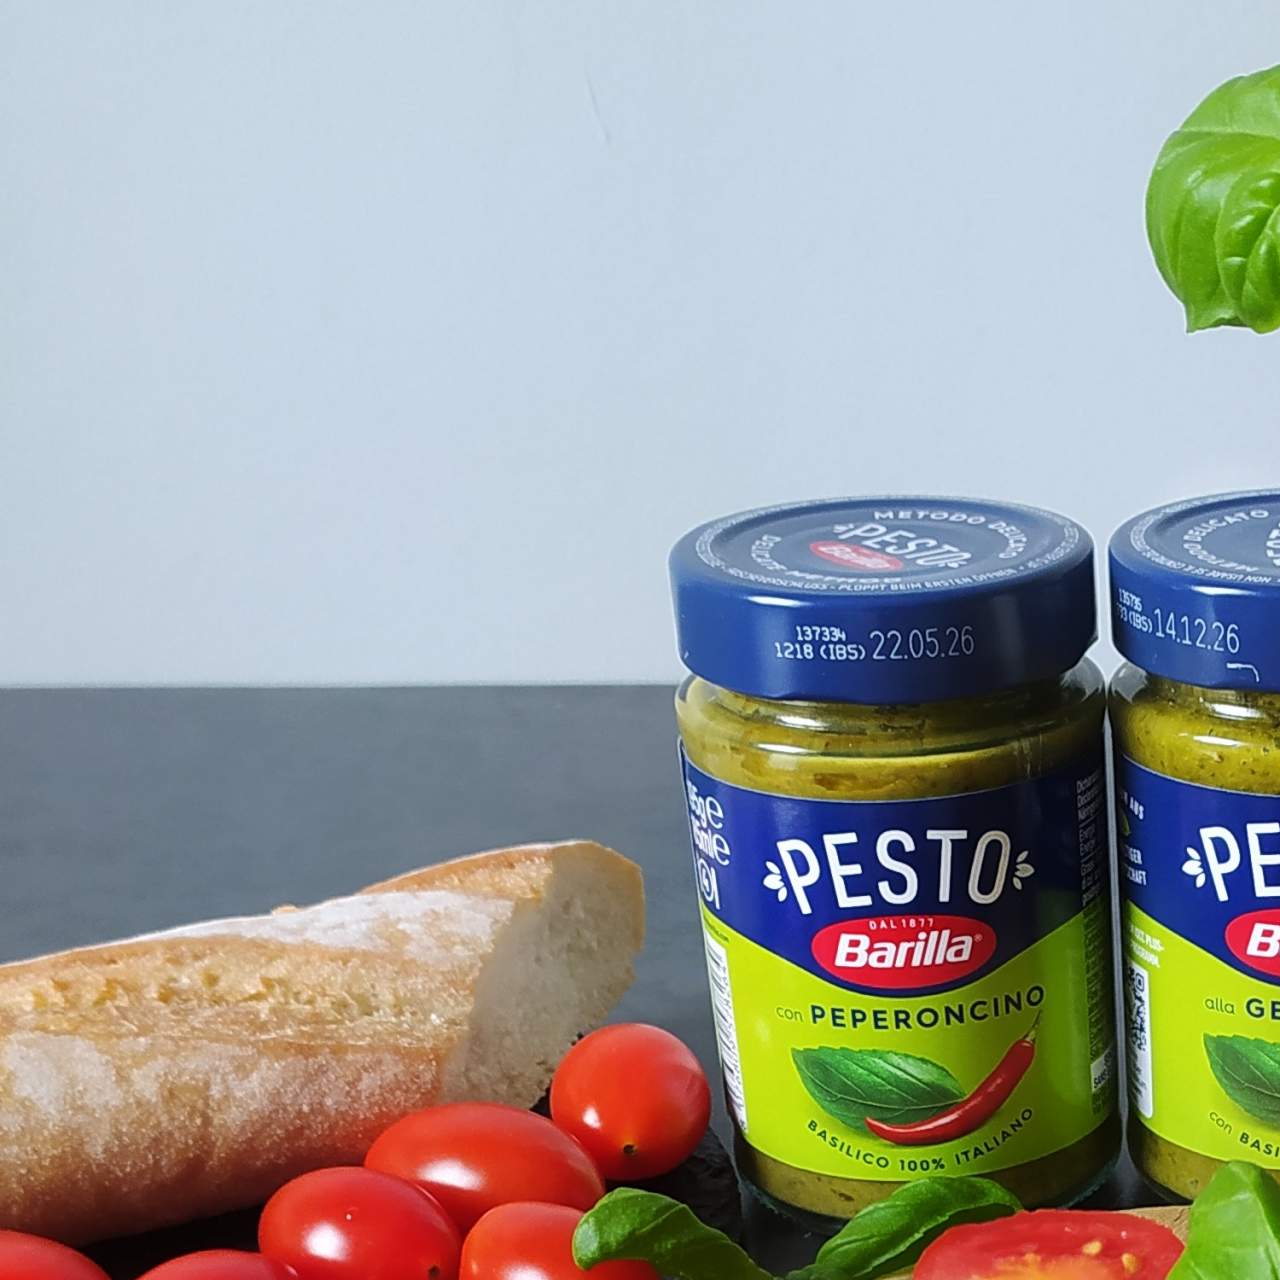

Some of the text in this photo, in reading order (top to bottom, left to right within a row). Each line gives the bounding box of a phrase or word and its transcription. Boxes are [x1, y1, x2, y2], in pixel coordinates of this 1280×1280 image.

[874, 510, 986, 525] METODO
[838, 523, 972, 567] PESTO
[869, 626, 975, 660] 22.05.26
[1153, 608, 1240, 654] 14.12.26
[774, 642, 814, 660] 1218
[776, 829, 1013, 915] PESTO
[869, 917, 935, 931] DAL 1877
[775, 985, 1045, 1030] con PEPERONCINO
[1204, 995, 1235, 1016] alla
[807, 1107, 1034, 1172] BASILICO 100% ITALIANO
[1209, 1110, 1233, 1135] con
